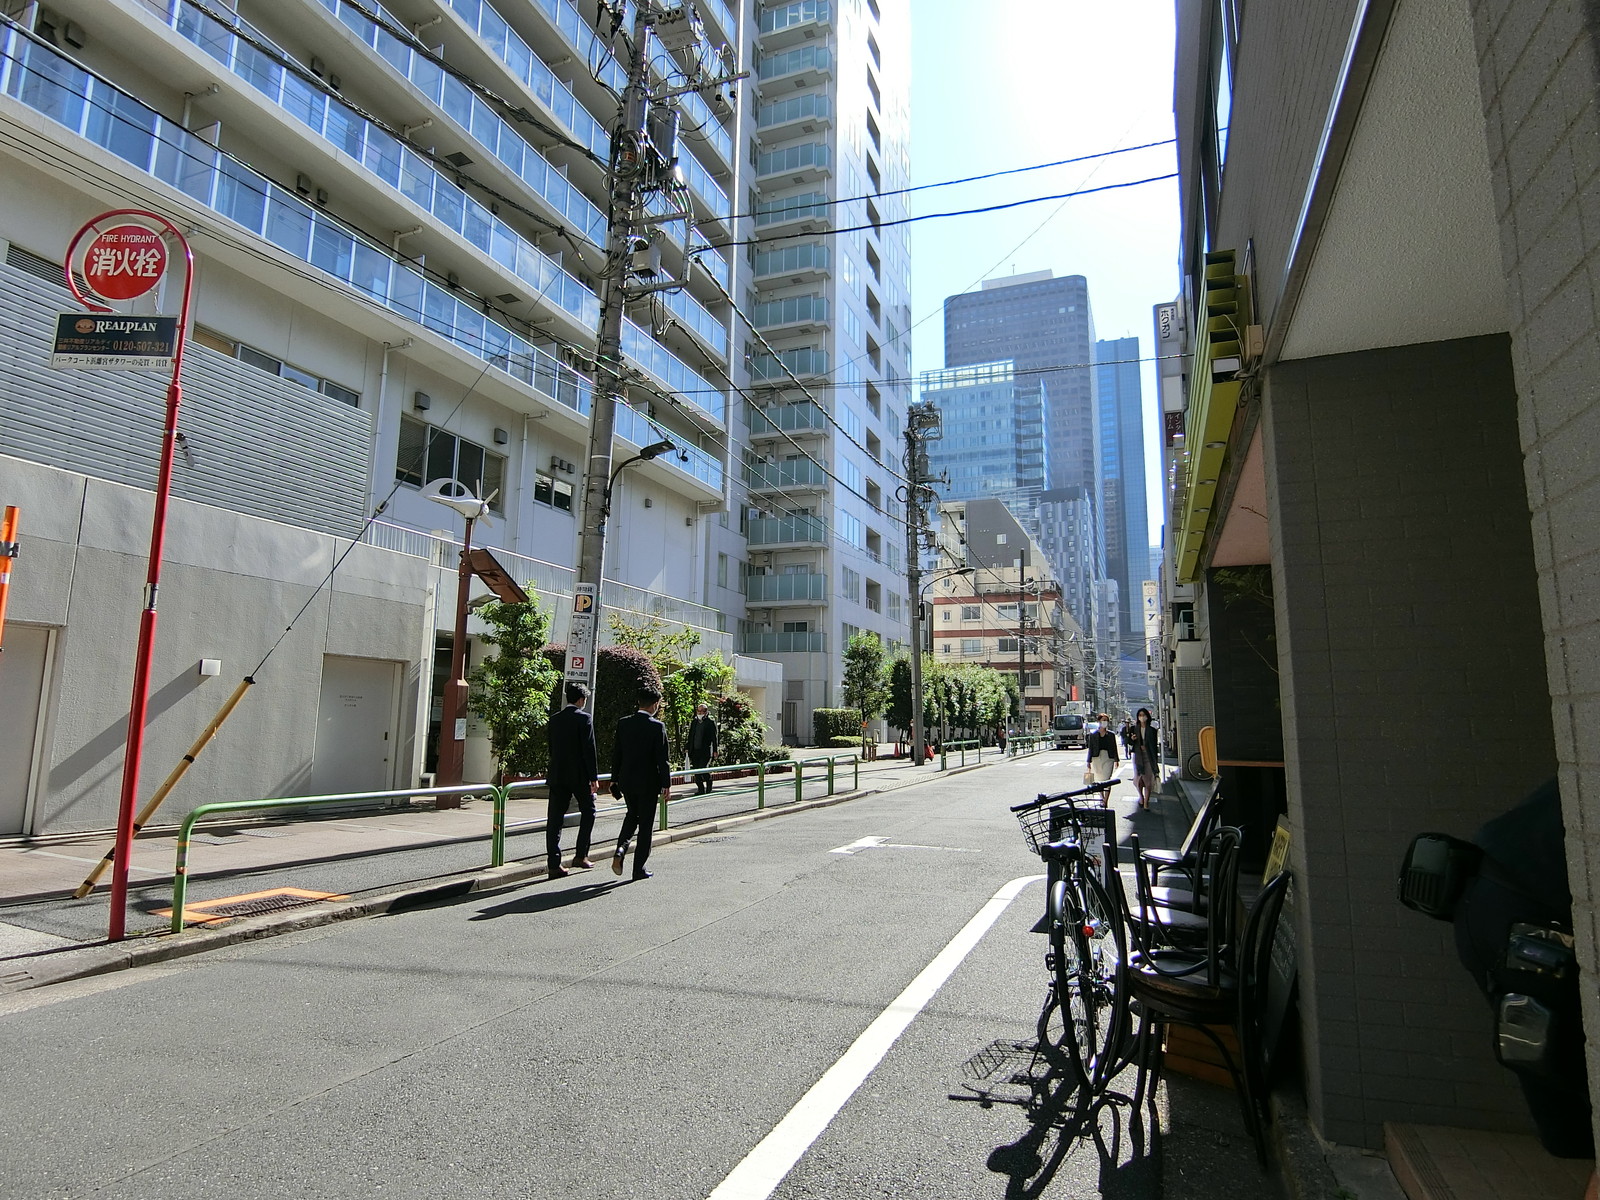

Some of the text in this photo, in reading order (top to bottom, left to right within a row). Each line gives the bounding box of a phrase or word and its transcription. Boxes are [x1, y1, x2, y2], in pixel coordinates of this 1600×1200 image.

[101, 234, 157, 243] FIRE HYDRANT
[90, 247, 162, 277] 消火栓
[95, 320, 157, 333] REALPLAN
